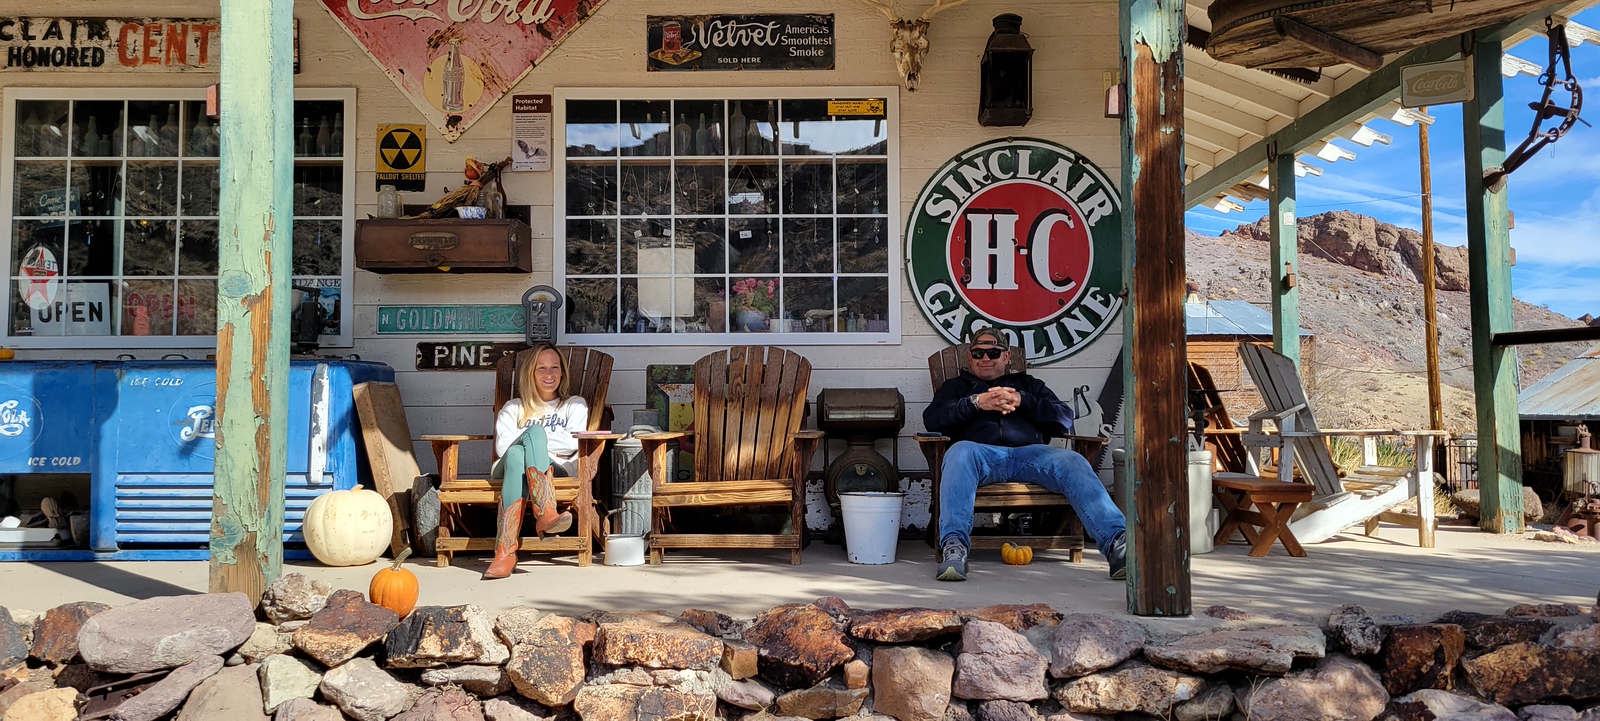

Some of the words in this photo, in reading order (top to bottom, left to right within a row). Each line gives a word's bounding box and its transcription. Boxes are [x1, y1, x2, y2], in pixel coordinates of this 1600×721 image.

[699, 20, 780, 49] Velvet
[785, 25, 829, 34] America's
[781, 36, 832, 46] Smoothest
[789, 47, 824, 57] Smoke
[8, 46, 105, 68] HONORED
[925, 149, 1114, 226] SINCLAIR
[966, 213, 1077, 293] H-C
[38, 301, 103, 323] OPEN
[127, 293, 195, 320] OPEN
[396, 308, 487, 330] GOLDMINE
[434, 345, 493, 366] PINE
[28, 457, 45, 466] ICE
[51, 457, 81, 466] COLD
